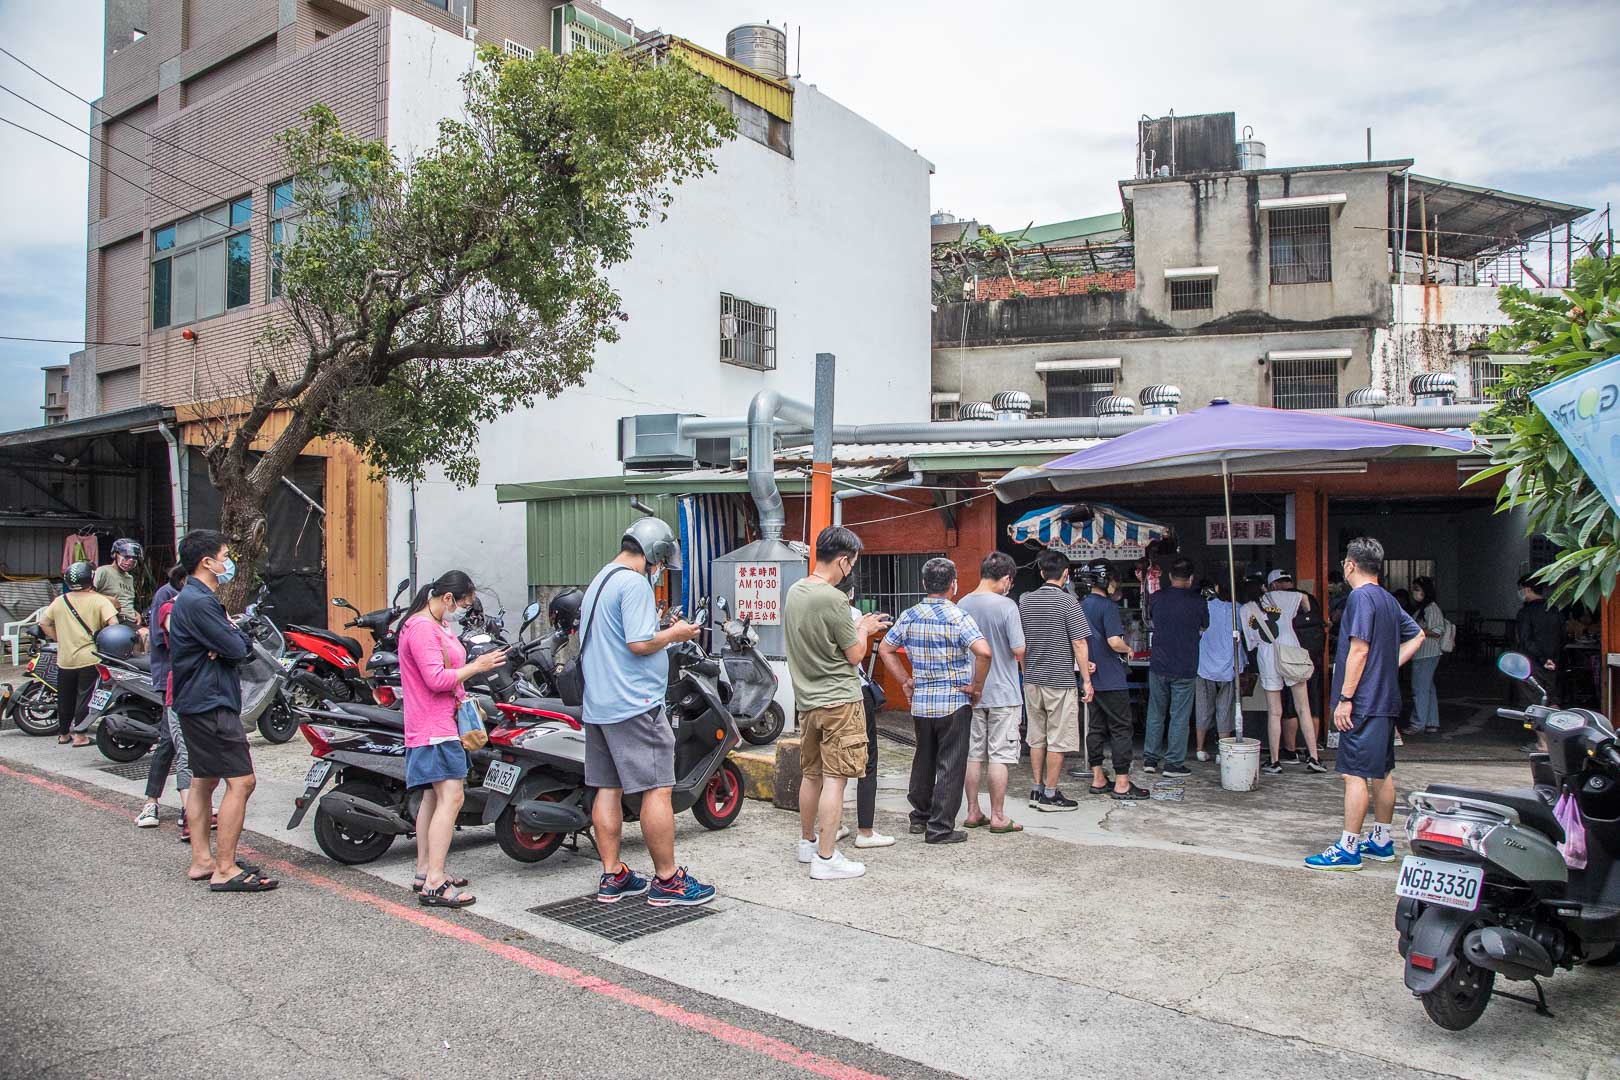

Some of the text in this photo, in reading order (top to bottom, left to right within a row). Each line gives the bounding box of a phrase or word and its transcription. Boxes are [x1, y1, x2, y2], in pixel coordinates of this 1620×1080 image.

[739, 566, 777, 577] 營業時間
[739, 579, 752, 589] AM
[739, 599, 777, 610] PM 19:00
